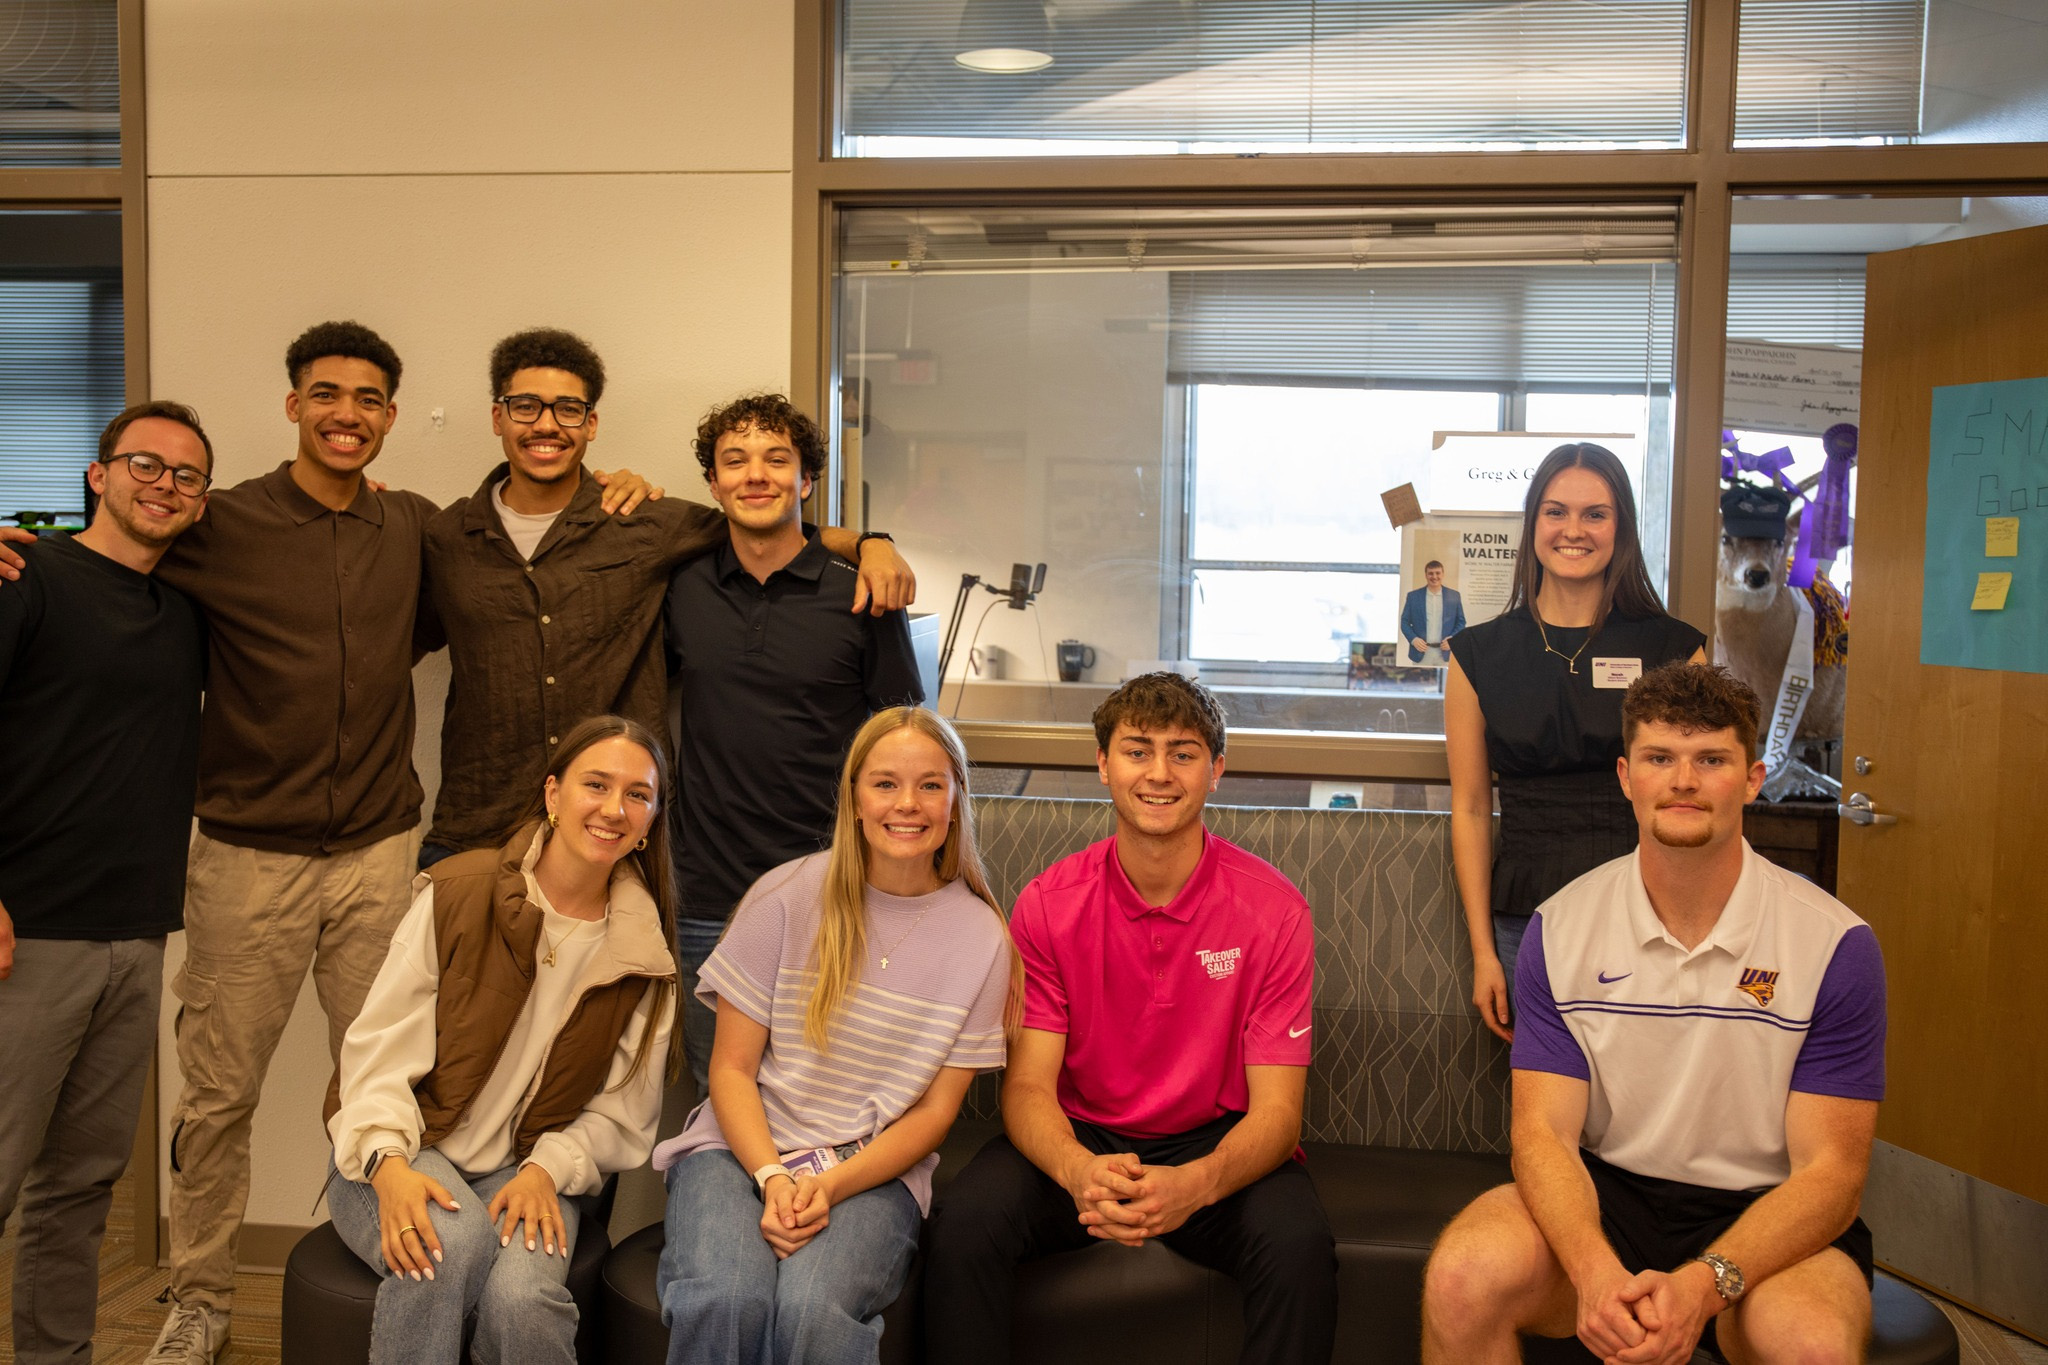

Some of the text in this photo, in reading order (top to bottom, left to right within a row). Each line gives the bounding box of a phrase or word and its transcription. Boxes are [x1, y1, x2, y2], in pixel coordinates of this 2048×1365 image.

[1468, 467, 1503, 483] Greg
[1506, 468, 1518, 480] &
[1463, 533, 1508, 544] KADIN
[1463, 548, 1518, 559] WALTER
[1770, 674, 1809, 762] BIRTHDAY
[1195, 947, 1241, 966] TAKEOVER
[1207, 960, 1235, 975] SALES
[1739, 967, 1780, 985] UNI
[818, 1149, 828, 1162] UNI
